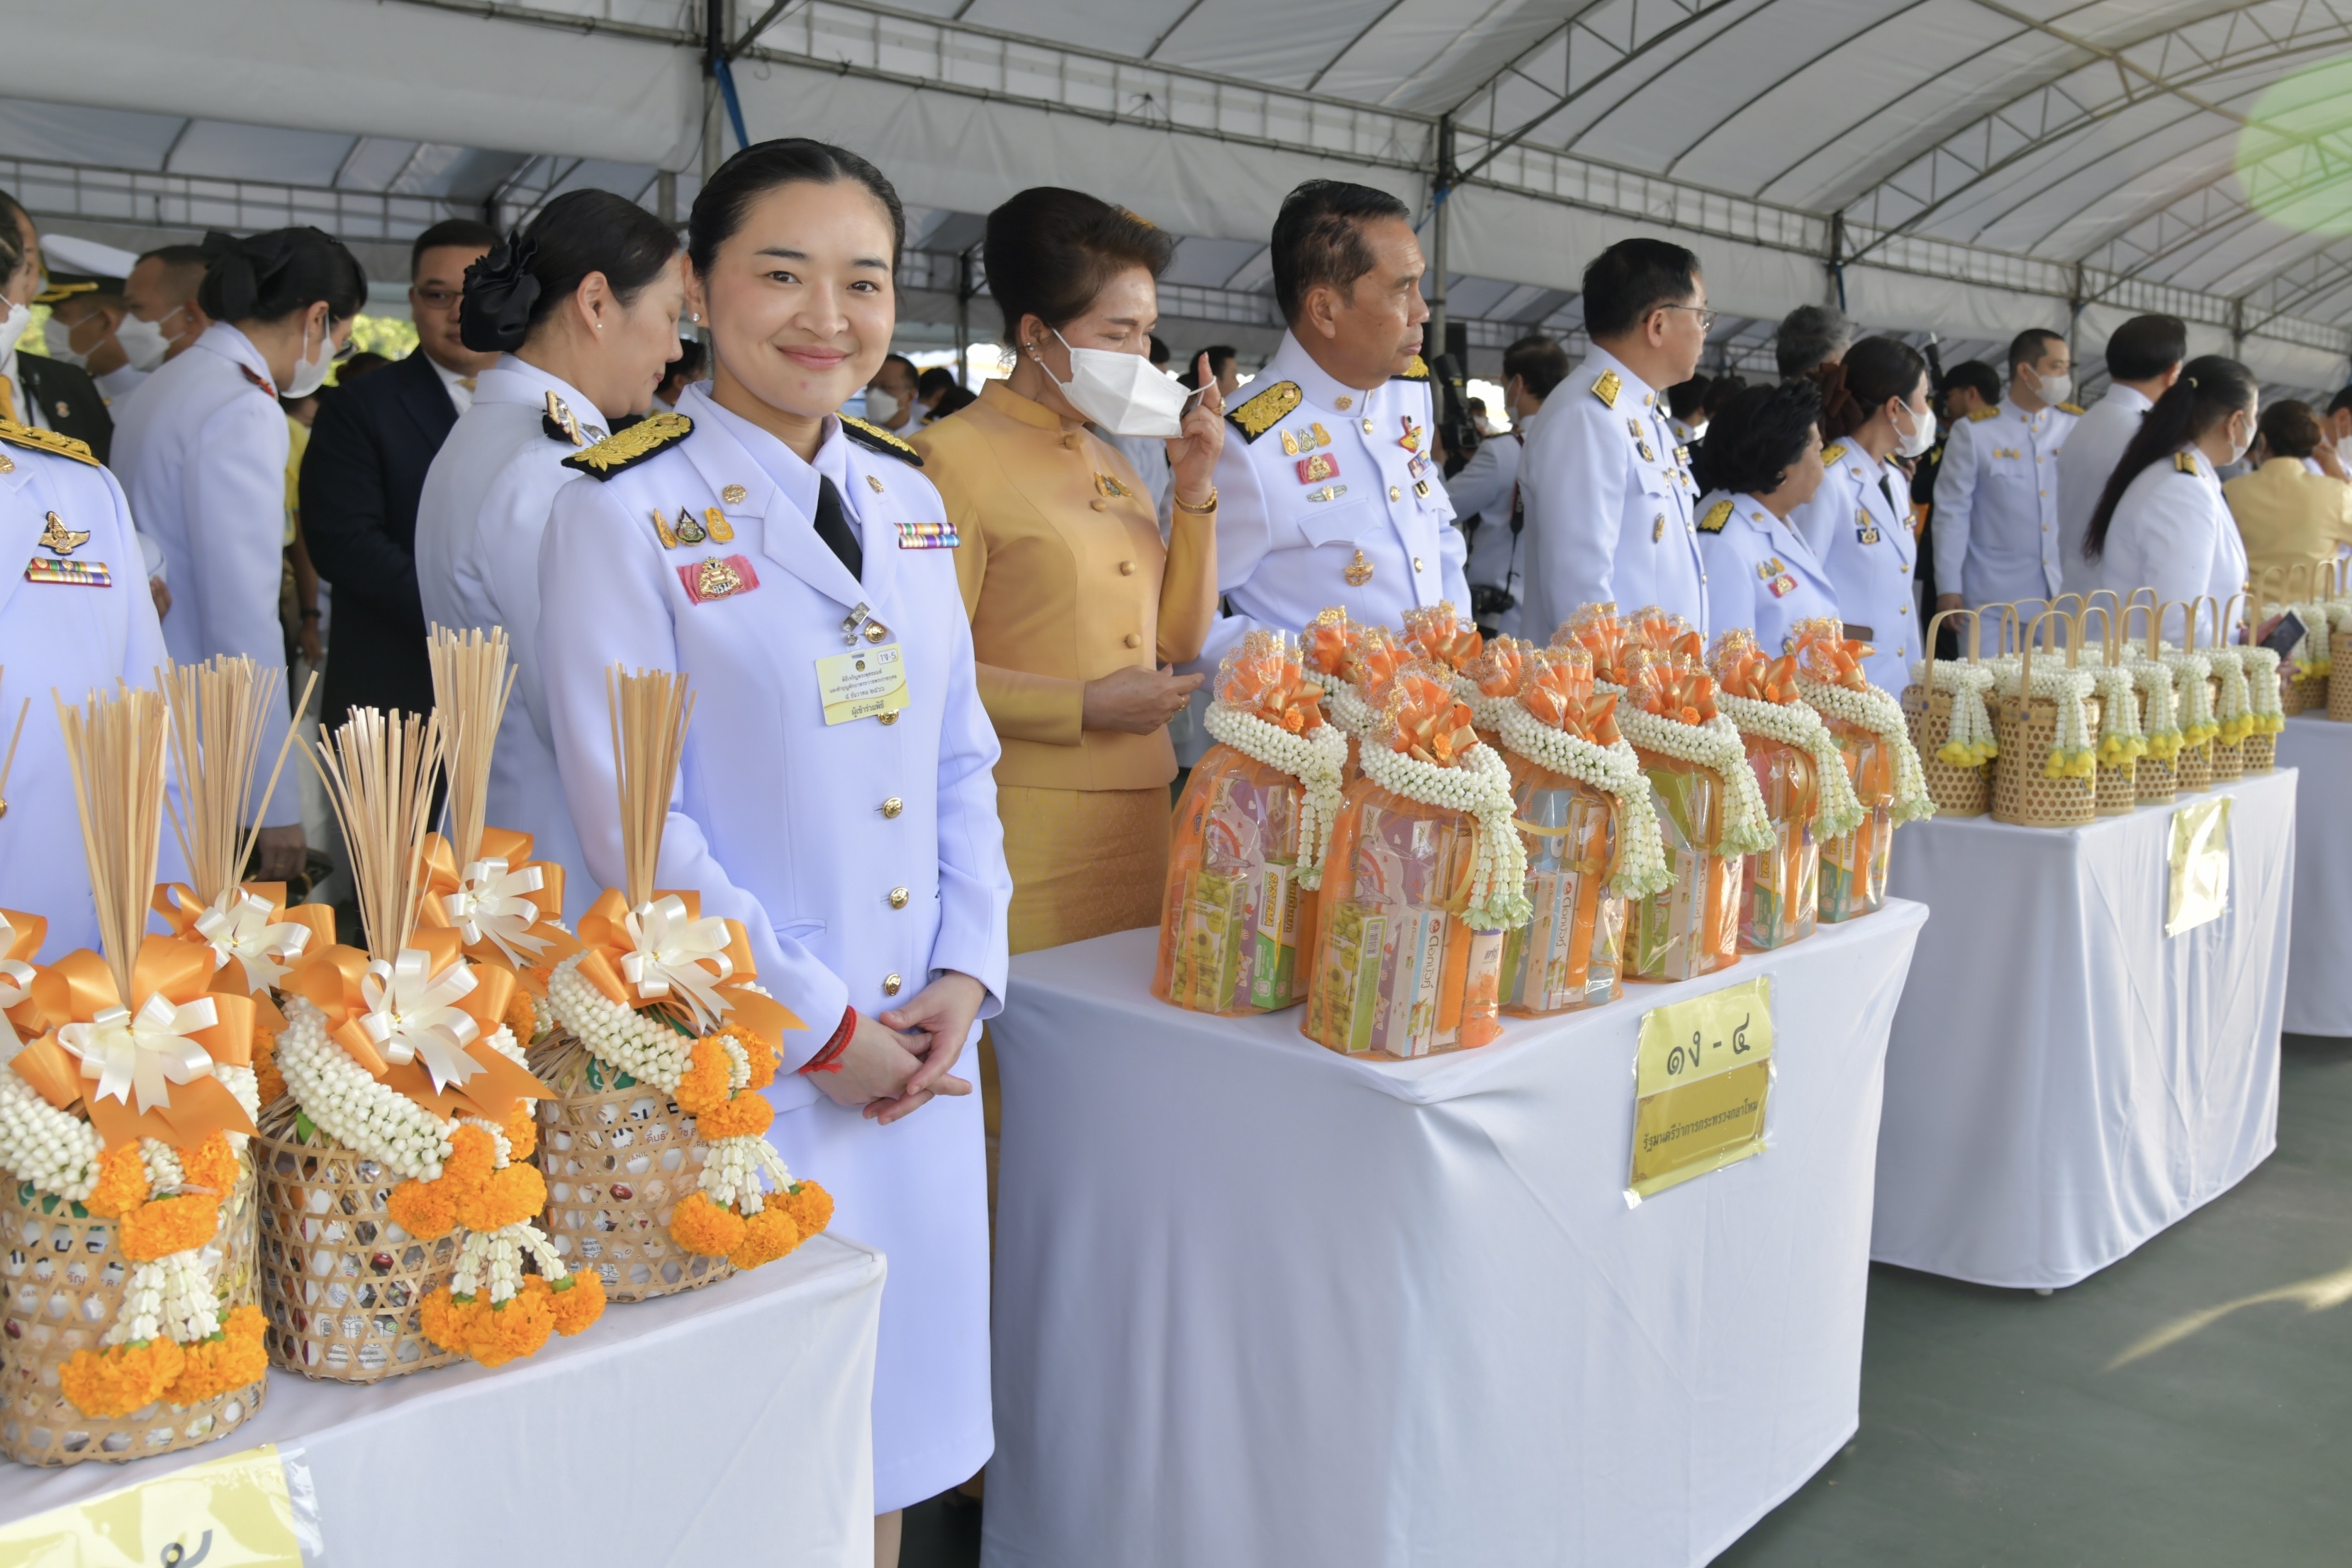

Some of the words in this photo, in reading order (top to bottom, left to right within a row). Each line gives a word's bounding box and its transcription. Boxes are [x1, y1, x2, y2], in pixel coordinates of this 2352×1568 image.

[851, 700, 885, 718] ผู้เข้าร่วมพิธี
[1265, 872, 1279, 927] SYSTEMA
[1421, 936, 1439, 989] ดอกบัวคู่
[1732, 1013, 1751, 1055] ๔
[1642, 1098, 1758, 1153] รัฐมนตรีว่าการกระทรวงกลาโหม
